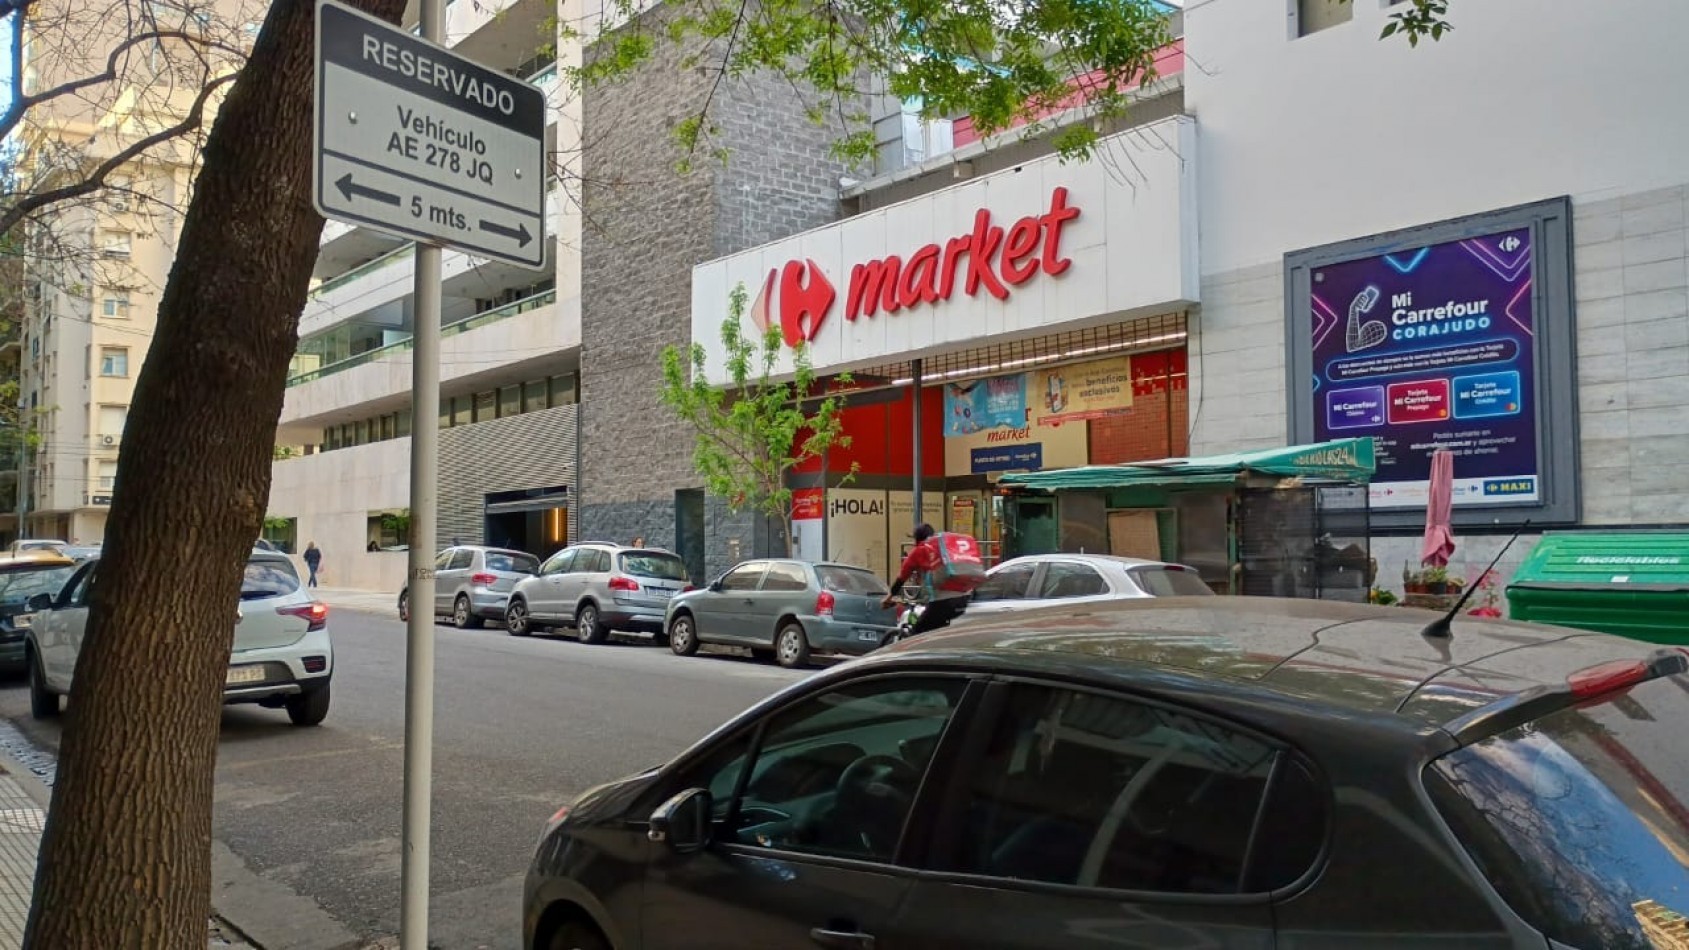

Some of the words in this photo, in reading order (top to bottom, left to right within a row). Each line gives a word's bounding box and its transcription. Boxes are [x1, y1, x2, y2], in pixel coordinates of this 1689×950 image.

[363, 33, 514, 115] RESERVADO
[397, 105, 486, 155] Vehículo
[387, 132, 418, 159] AE
[425, 143, 460, 173] 278
[467, 163, 493, 185] JQ
[411, 196, 422, 218] 5
[430, 206, 472, 231] mts.
[845, 186, 1080, 321] market
[1391, 291, 1411, 308] Mi
[1391, 300, 1489, 325] Carrefour
[1392, 317, 1491, 340] CORAJUDO
[986, 424, 1030, 443] market
[1500, 482, 1531, 492] MAXI
[831, 498, 884, 517] ¡HOLA!
